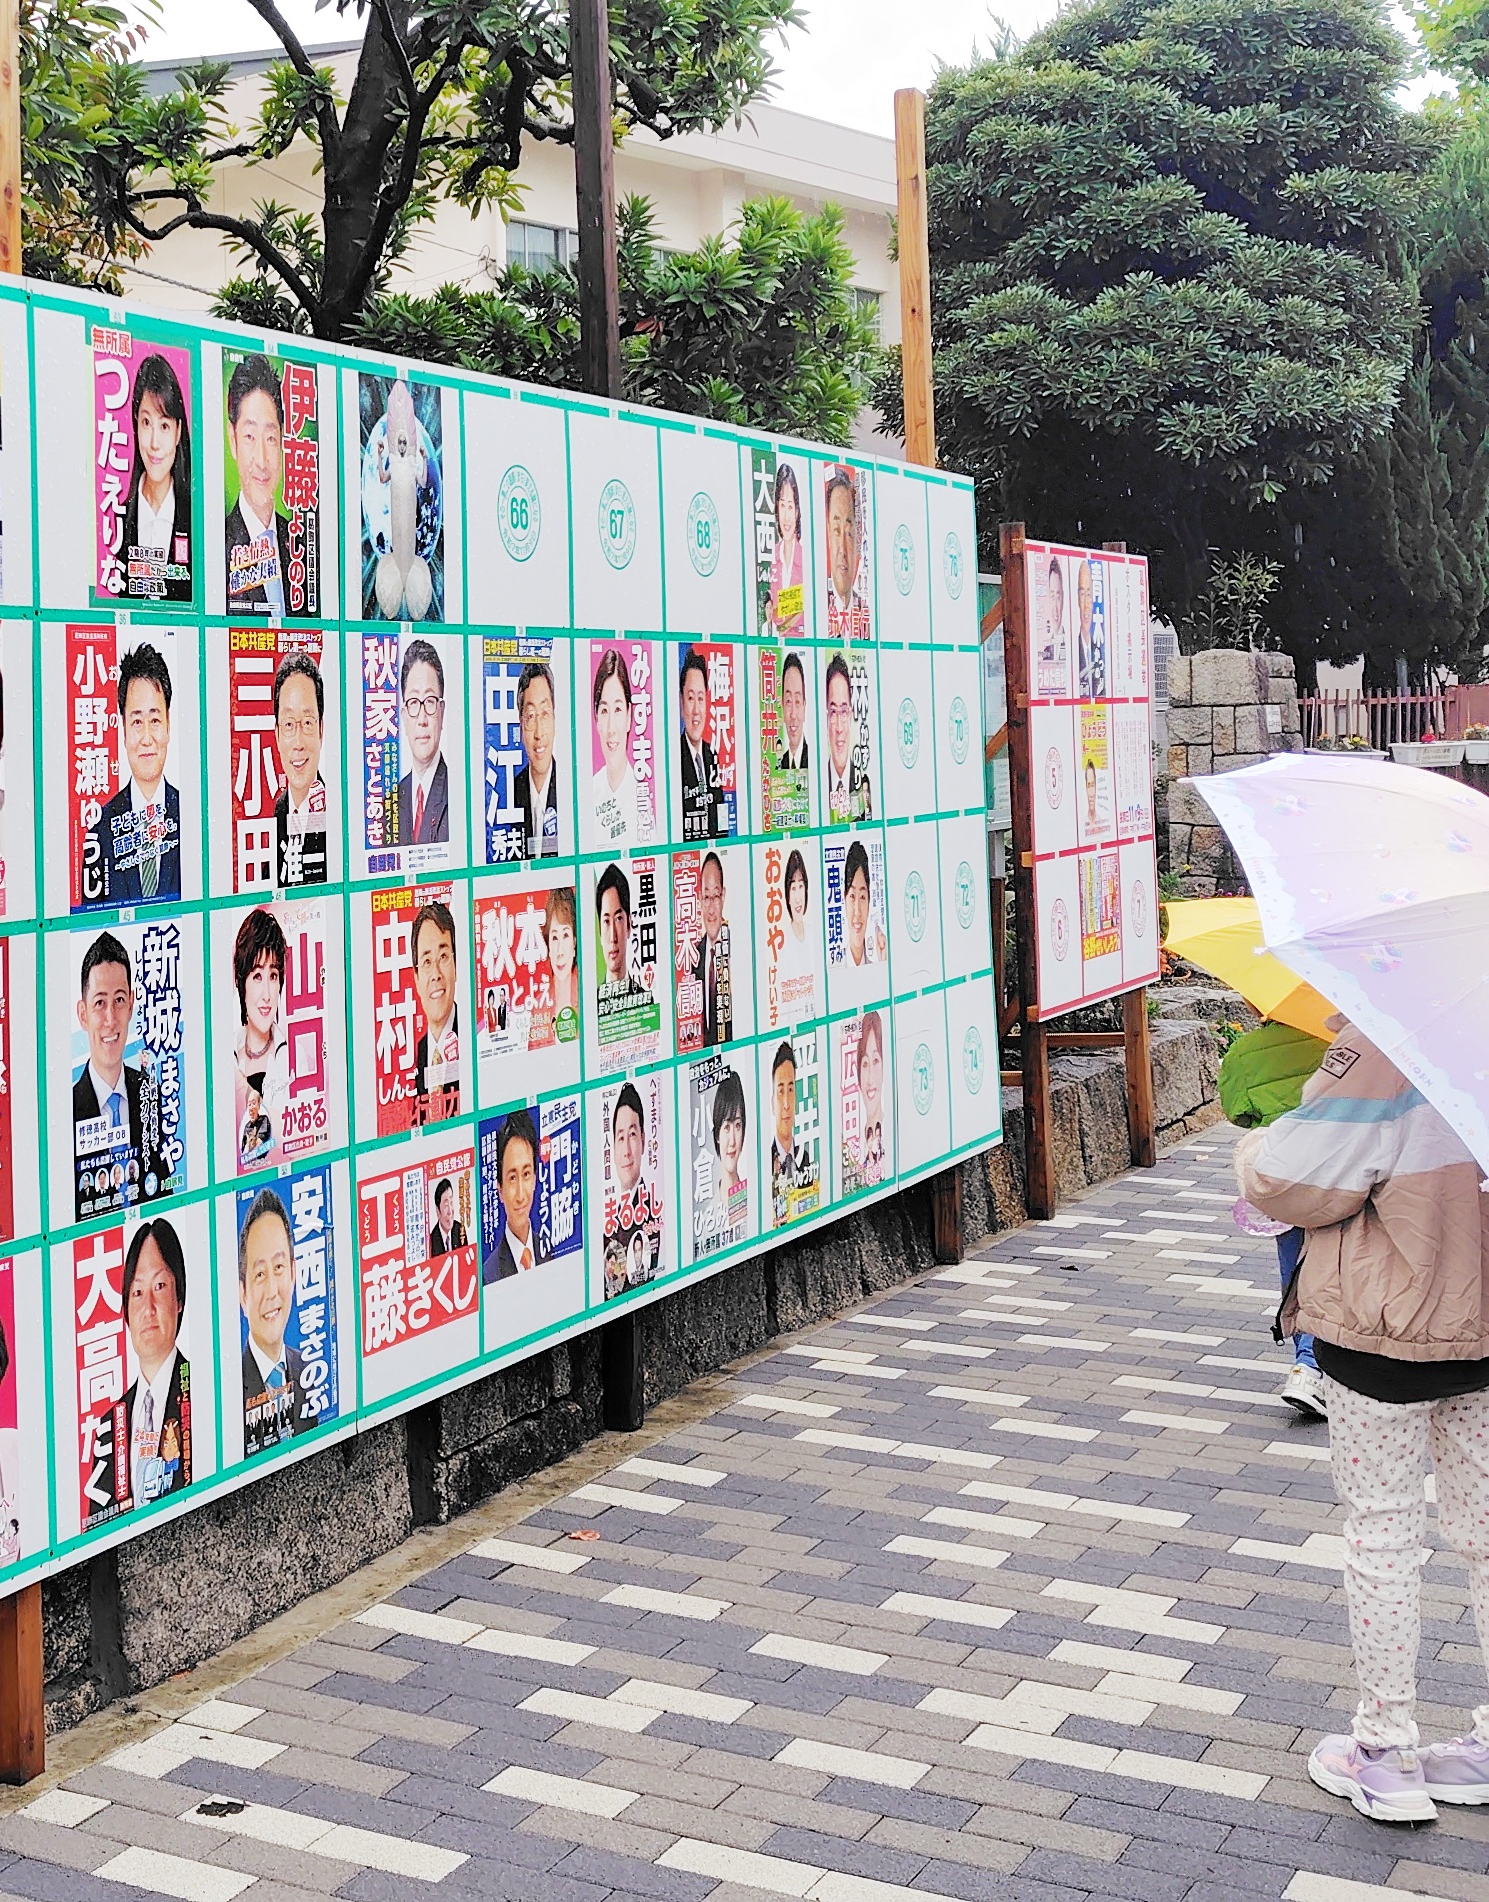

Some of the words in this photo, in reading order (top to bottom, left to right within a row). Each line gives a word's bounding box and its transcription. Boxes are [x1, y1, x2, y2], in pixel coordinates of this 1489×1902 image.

[91, 327, 133, 357] 無所属
[95, 358, 130, 594] つたえりな
[282, 361, 320, 612] 伊藤よしのり
[510, 496, 529, 530] 66
[609, 509, 625, 540] 67
[753, 459, 776, 564] 大西
[696, 520, 711, 550] 68
[230, 632, 276, 651] 日本共産党
[364, 636, 398, 847] 秋家さとあき
[485, 664, 525, 828] 中江
[708, 652, 732, 755] 梅沢
[73, 645, 111, 899] 小野瀬ゆうじ
[234, 657, 280, 891] 三小田
[372, 889, 413, 913] 日本共産党
[482, 901, 548, 982] 秋本
[639, 873, 657, 967] 黒田
[765, 847, 785, 1027] おおやけい子
[827, 864, 844, 945] 鬼頭
[285, 932, 325, 1100] 山口
[375, 911, 418, 1075] 中村
[511, 974, 554, 1013] とよえ
[142, 923, 184, 1174] 新城まさや
[378, 1068, 419, 1106] しんご
[281, 1098, 328, 1137] かおる
[541, 1100, 577, 1129] 立憲民主党
[692, 1094, 714, 1205] 小倉
[550, 1128, 573, 1247] 門脇
[604, 1183, 663, 1237] まるよし
[693, 1201, 728, 1238] ひろみ
[292, 1176, 330, 1419] 安西まさのぶ
[76, 1236, 125, 1507] 大高たく
